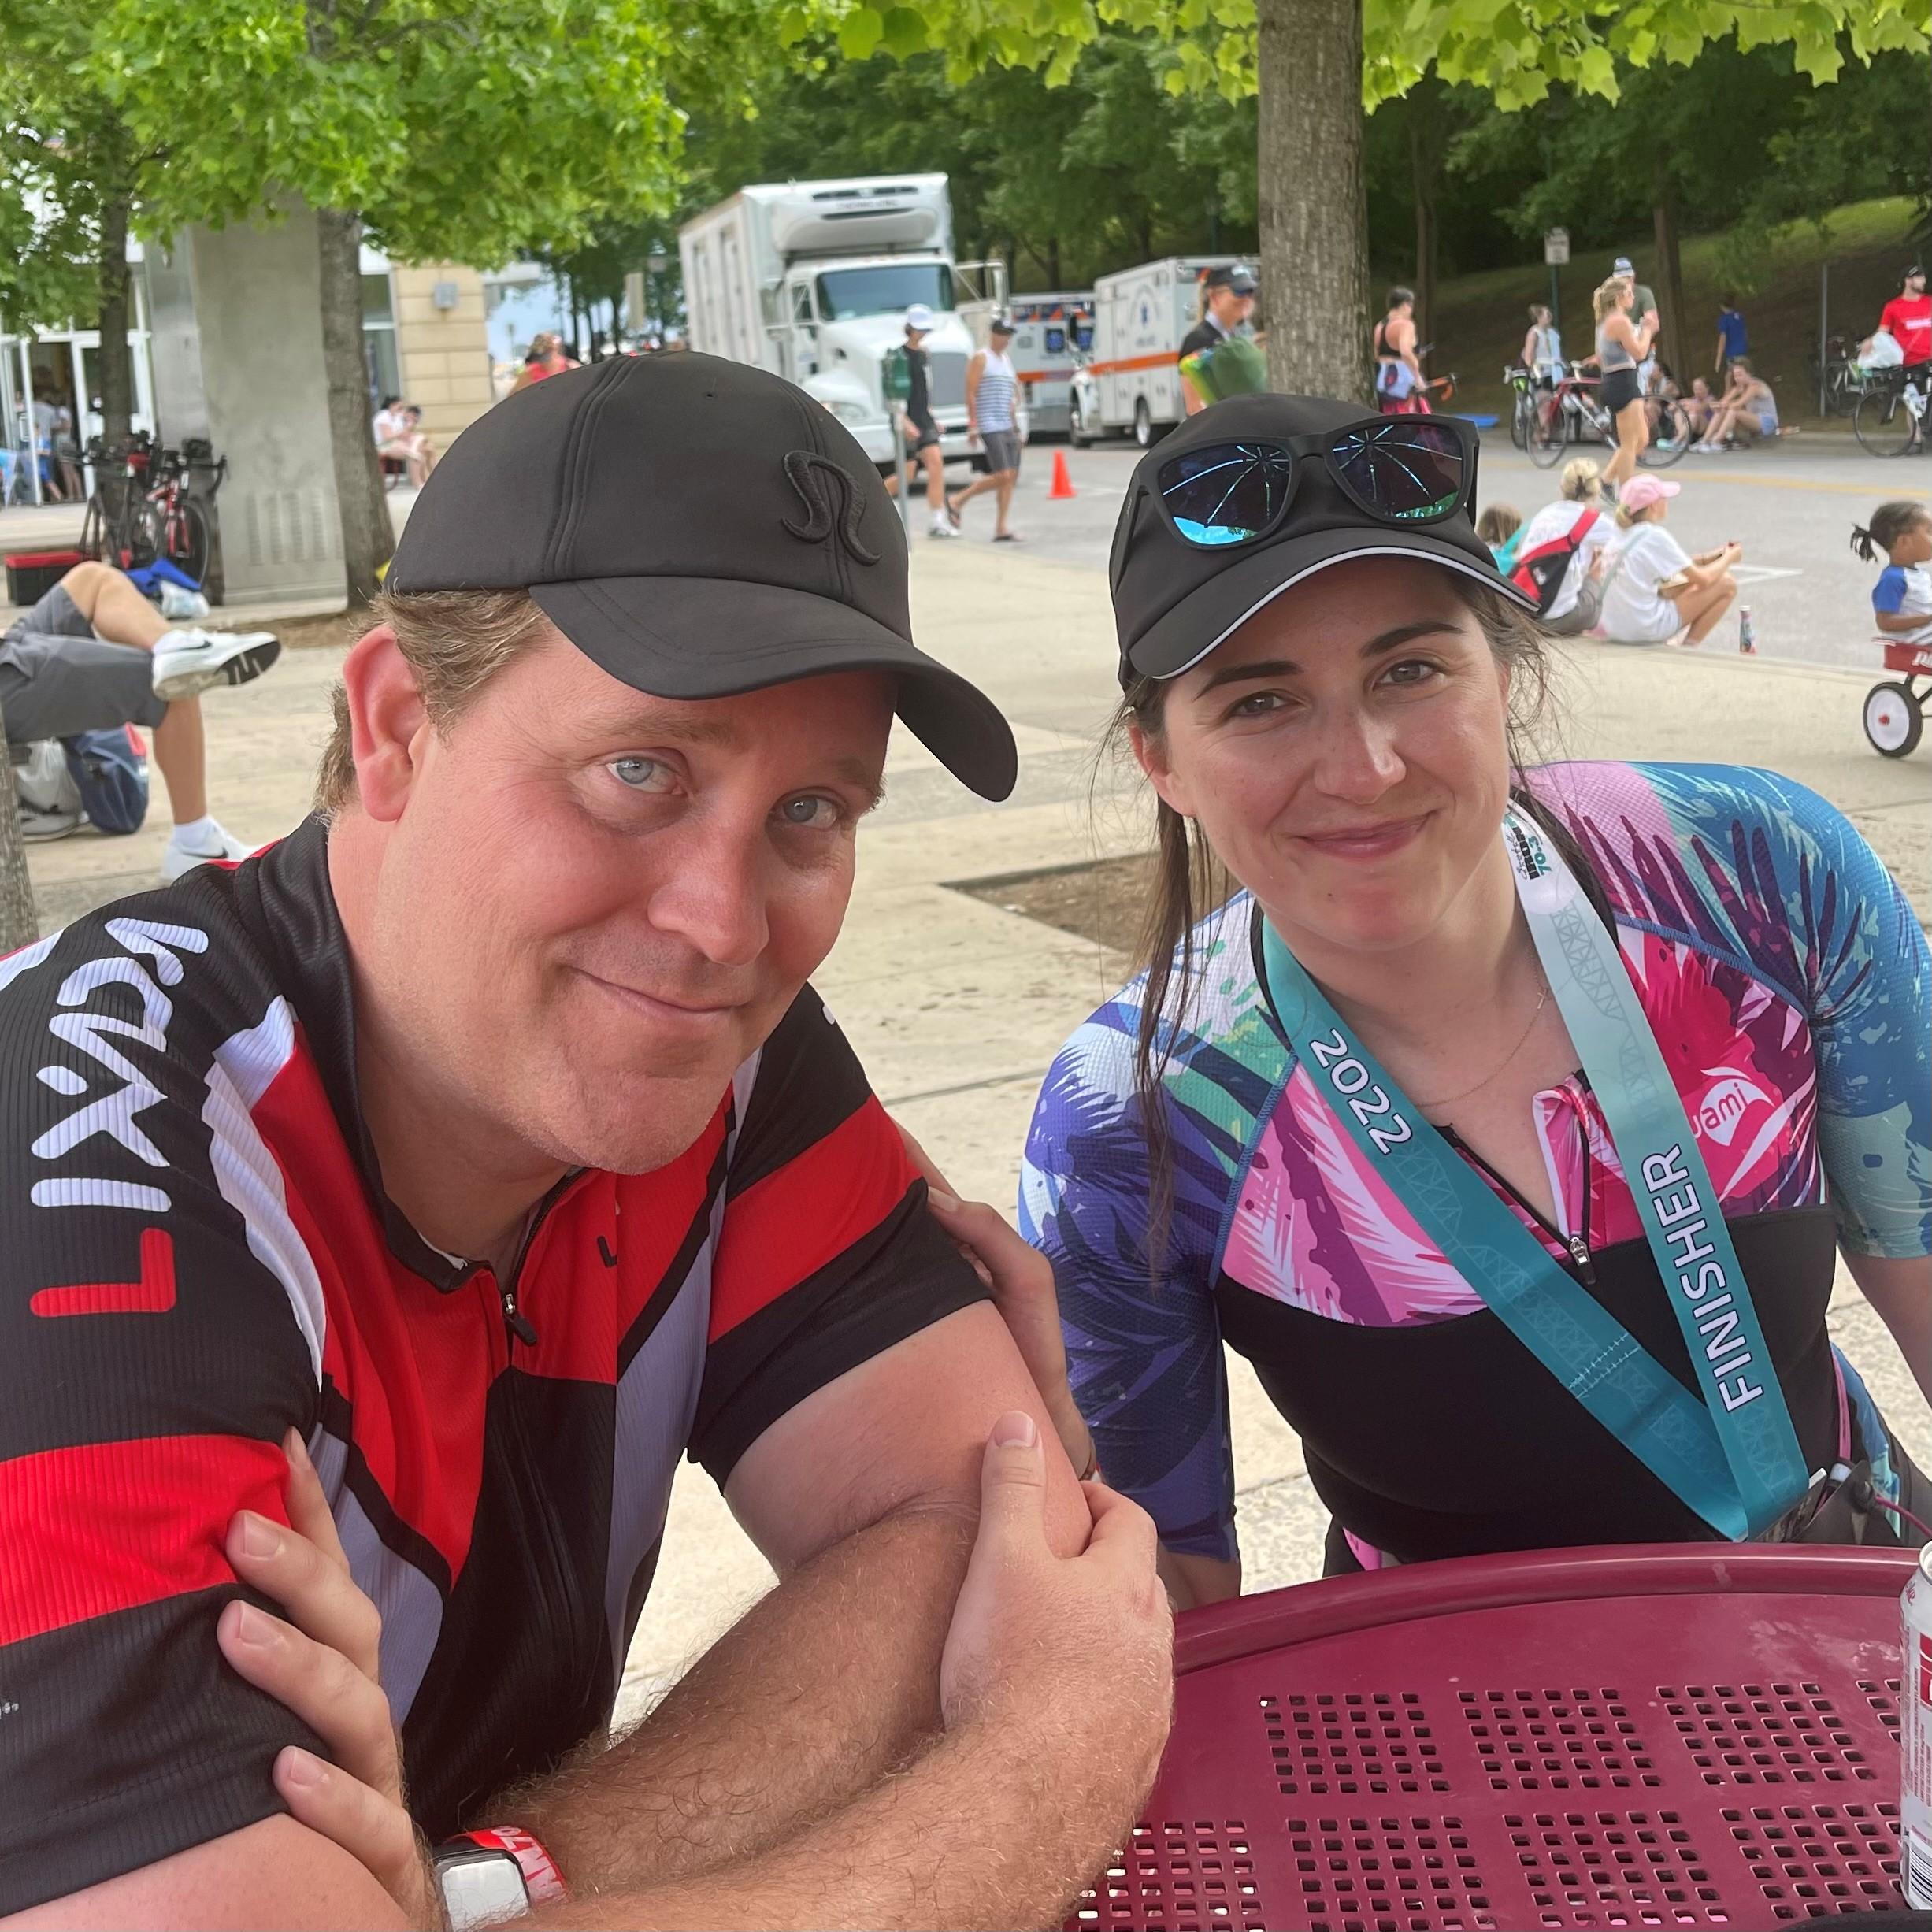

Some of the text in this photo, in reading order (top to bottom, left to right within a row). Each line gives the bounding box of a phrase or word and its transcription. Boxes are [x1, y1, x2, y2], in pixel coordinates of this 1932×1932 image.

[1528, 836, 1552, 876] 70.3
[1309, 1028, 1413, 1155] 2022
[1641, 1144, 1764, 1412] FINISHER
